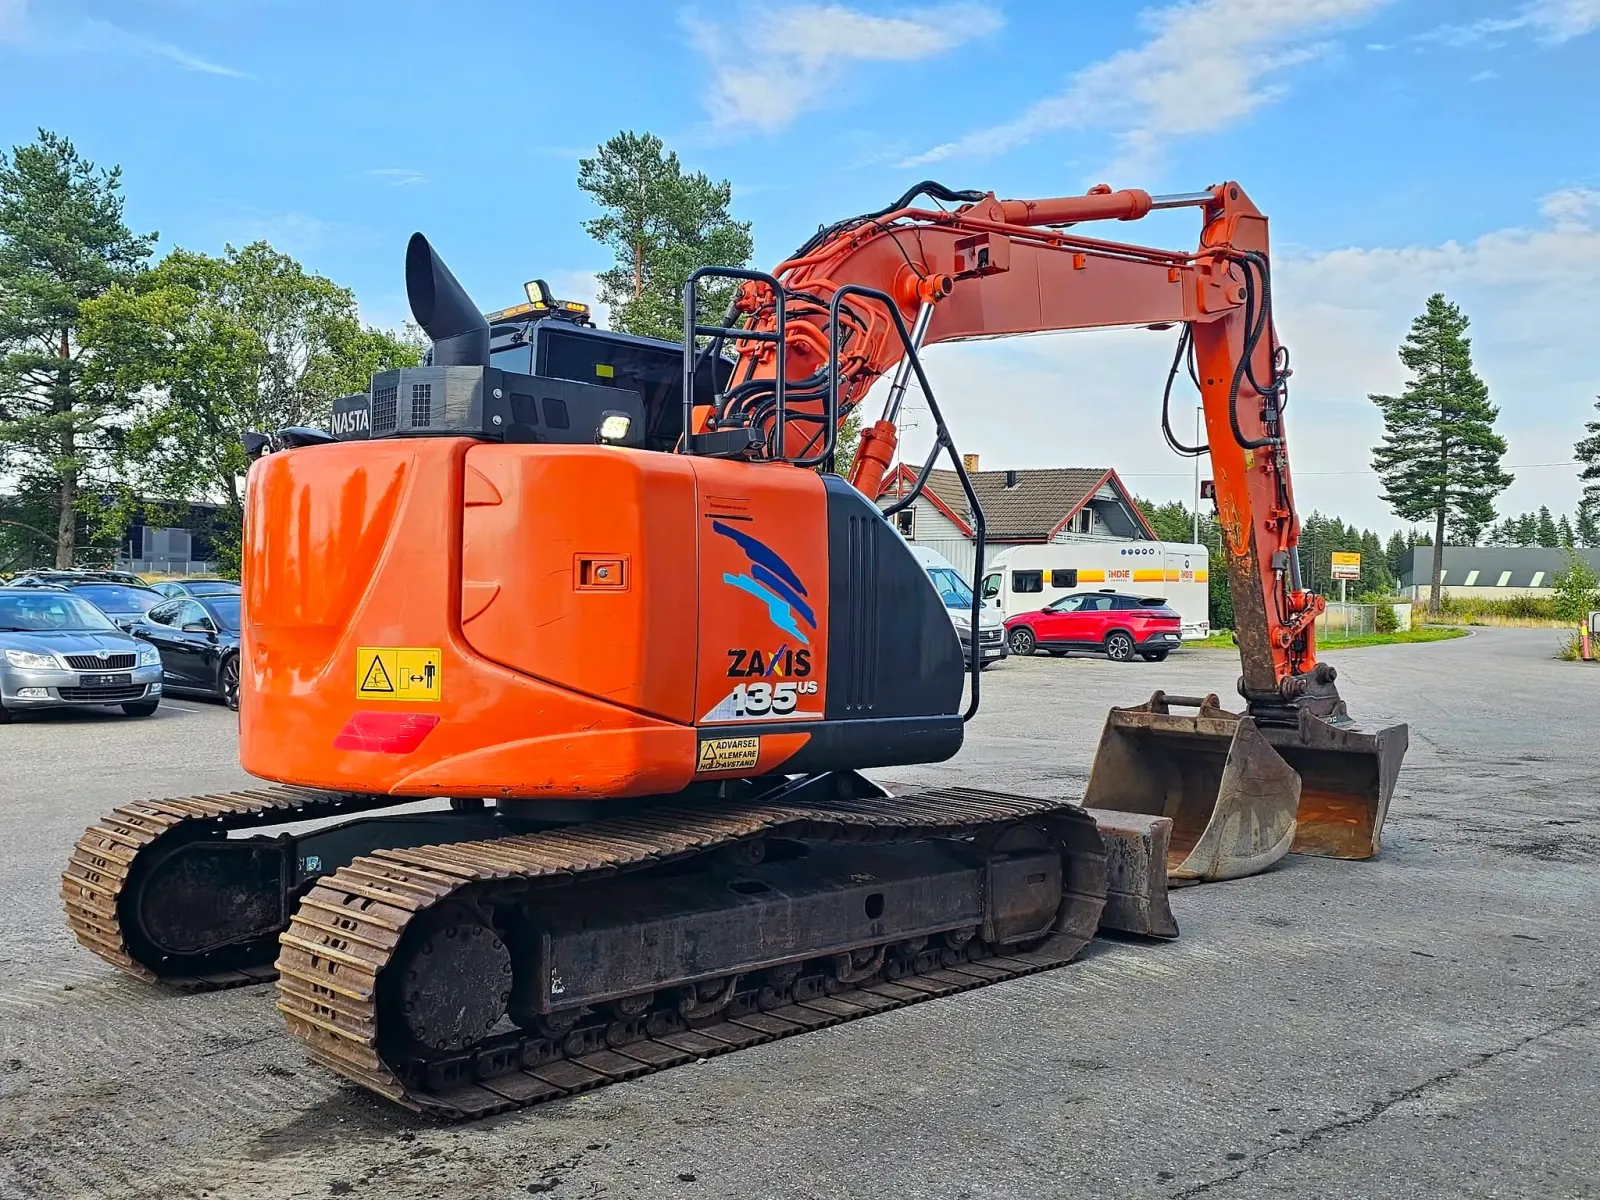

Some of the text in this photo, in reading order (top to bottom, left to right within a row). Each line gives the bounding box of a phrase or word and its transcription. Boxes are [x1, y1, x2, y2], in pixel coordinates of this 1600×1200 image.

[331, 409, 370, 435] NASTA
[727, 644, 811, 677] ZAXIS
[733, 681, 818, 717] 135 US
[716, 740, 757, 750] ADVARSEL
[719, 750, 757, 760] KLEMFARE
[721, 760, 755, 768] AVSTAND
